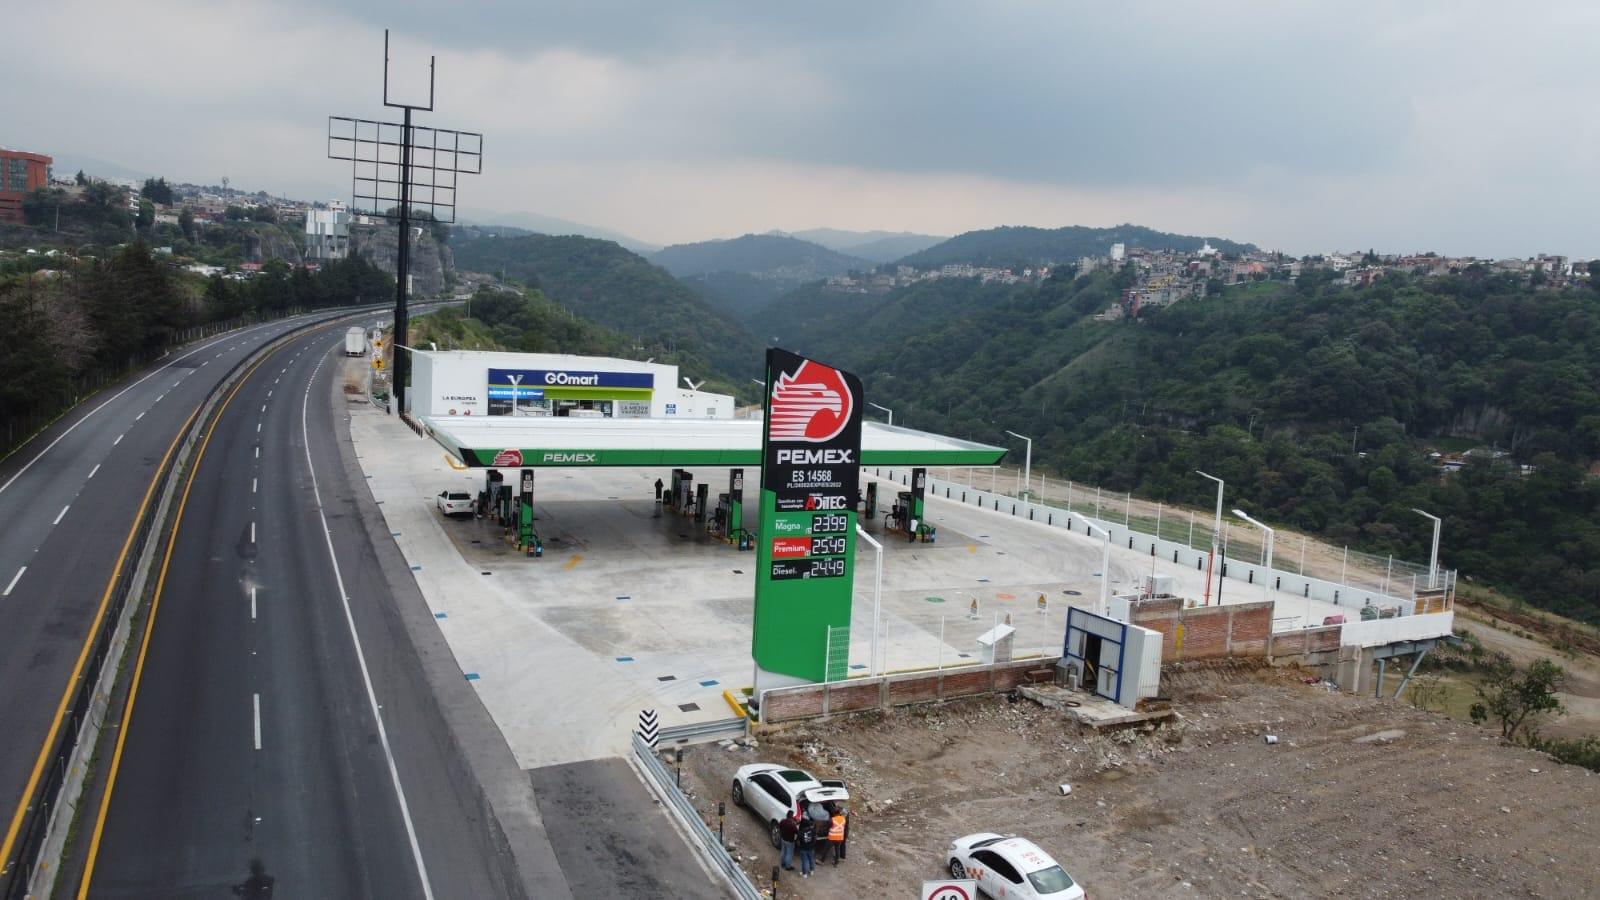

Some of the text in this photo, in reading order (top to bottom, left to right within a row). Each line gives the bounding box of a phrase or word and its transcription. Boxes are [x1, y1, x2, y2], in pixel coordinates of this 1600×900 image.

[545, 372, 599, 385] GOmart
[543, 453, 596, 462] PEMEX
[777, 449, 852, 464] PEMEX
[792, 469, 832, 482] ES 14568
[775, 522, 801, 532] Magna
[774, 545, 806, 553] Premium
[772, 567, 796, 576] Diesel
